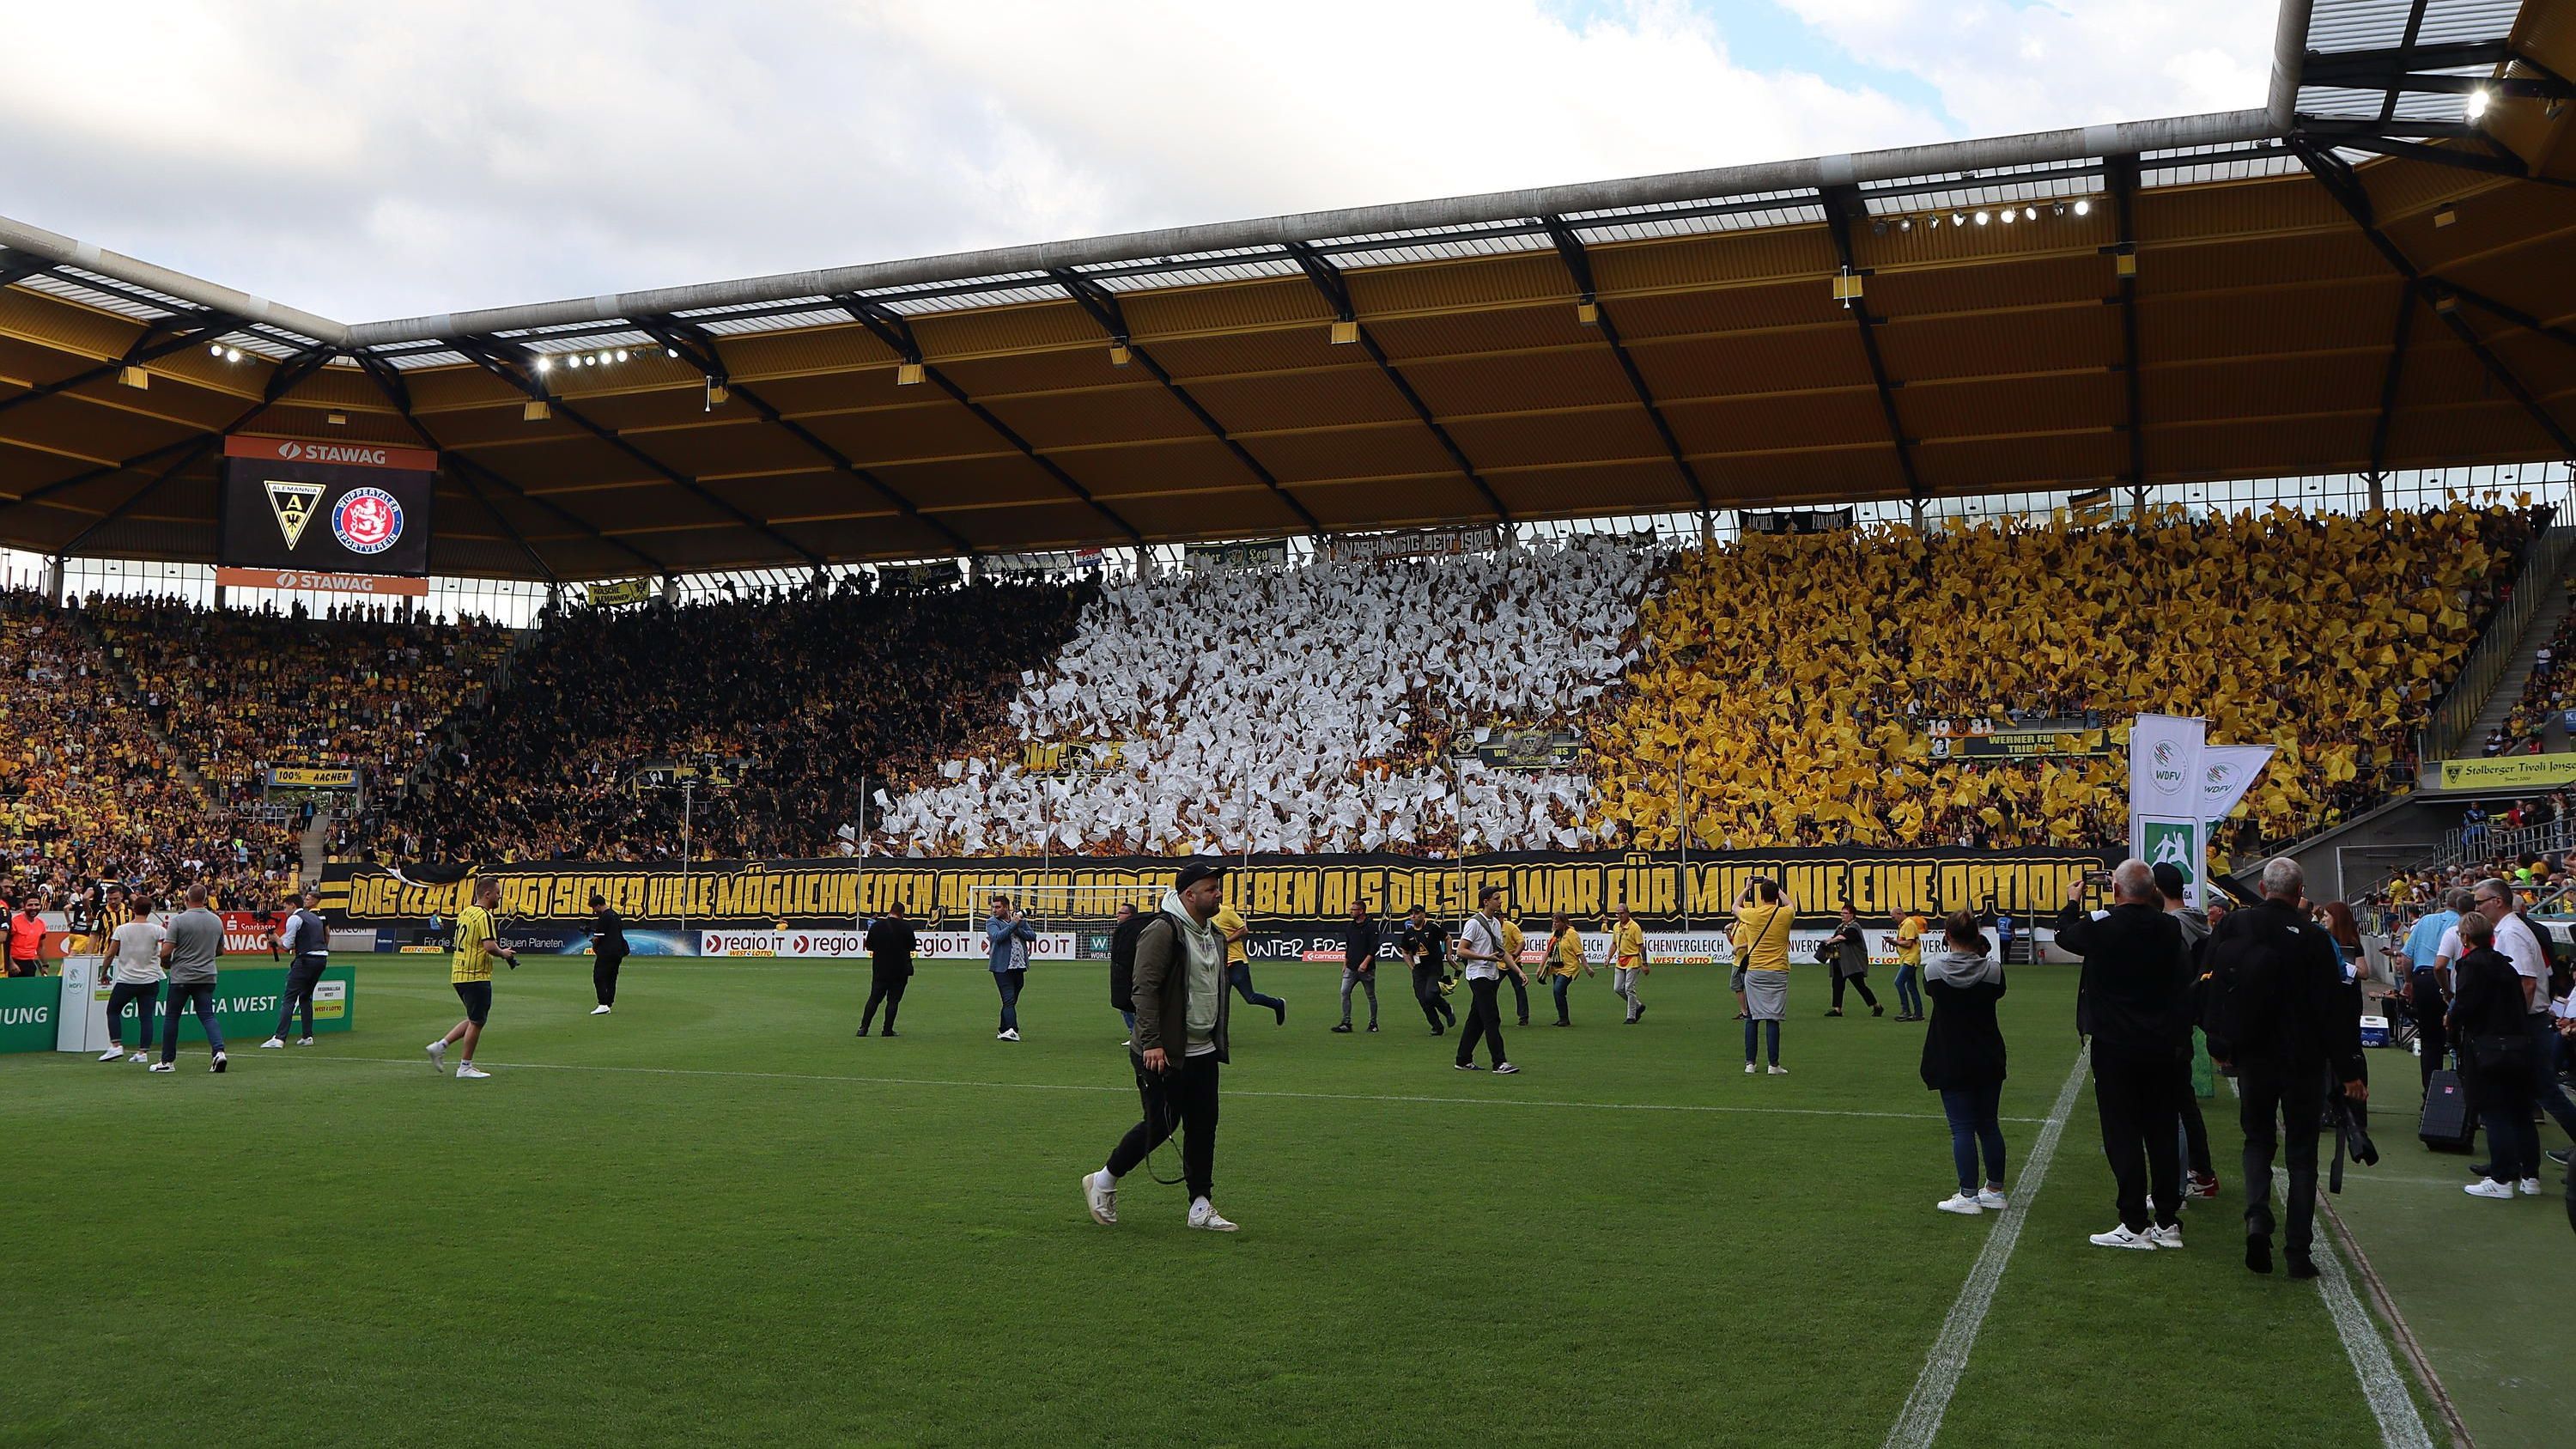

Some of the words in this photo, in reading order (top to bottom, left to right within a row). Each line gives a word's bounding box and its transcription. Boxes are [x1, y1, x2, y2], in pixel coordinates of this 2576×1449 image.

[305, 445, 386, 465] STAWAG
[286, 494, 302, 510] A
[337, 489, 399, 513] WUPPERTALER
[1747, 515, 1774, 530] AACHEN
[1812, 514, 1844, 529] FANATICS
[337, 530, 398, 552] SPORTVEREIN
[301, 575, 374, 591] STAWAG
[1929, 719, 1950, 736] 19
[1971, 718, 1995, 735] 81
[1989, 735, 2033, 745] WERNER
[2008, 744, 2056, 753] TRIBE
[279, 771, 302, 781] 100%
[313, 772, 349, 782] AACHEN
[2156, 770, 2182, 781] WDFV
[2466, 764, 2515, 776] Stolberger
[2518, 761, 2546, 772] Tivoli
[2205, 784, 2233, 794] WDFV
[349, 878, 399, 915] DAS
[489, 877, 553, 916] RGT
[554, 876, 645, 916] SICHER
[648, 876, 714, 916] VIELE
[716, 866, 933, 916] MÖGLICHKEITEN
[939, 874, 1016, 915] ABER
[1021, 874, 1067, 915] EIN
[1074, 873, 1177, 915] ANDER
[1223, 871, 1316, 915] LEBEN
[1322, 871, 1382, 915] ALS
[1516, 868, 1601, 915] WAR
[1607, 856, 1677, 915] FÜR
[1786, 866, 1844, 912] NIE
[1853, 864, 1933, 912] EINE
[224, 934, 268, 950] AWAG
[424, 936, 437, 947] Für
[438, 936, 450, 947] die
[500, 937, 528, 948] Blauen
[529, 937, 565, 949] Planeten.
[725, 932, 766, 952] regio
[772, 932, 785, 951] iT
[813, 932, 858, 955] regio
[914, 934, 951, 957] egio
[957, 934, 969, 952] iT
[1055, 934, 1070, 953] iT
[1091, 938, 1107, 948] W
[1246, 938, 1303, 957] UNTER
[233, 995, 276, 1013] WEST
[0, 1006, 48, 1025] UNG
